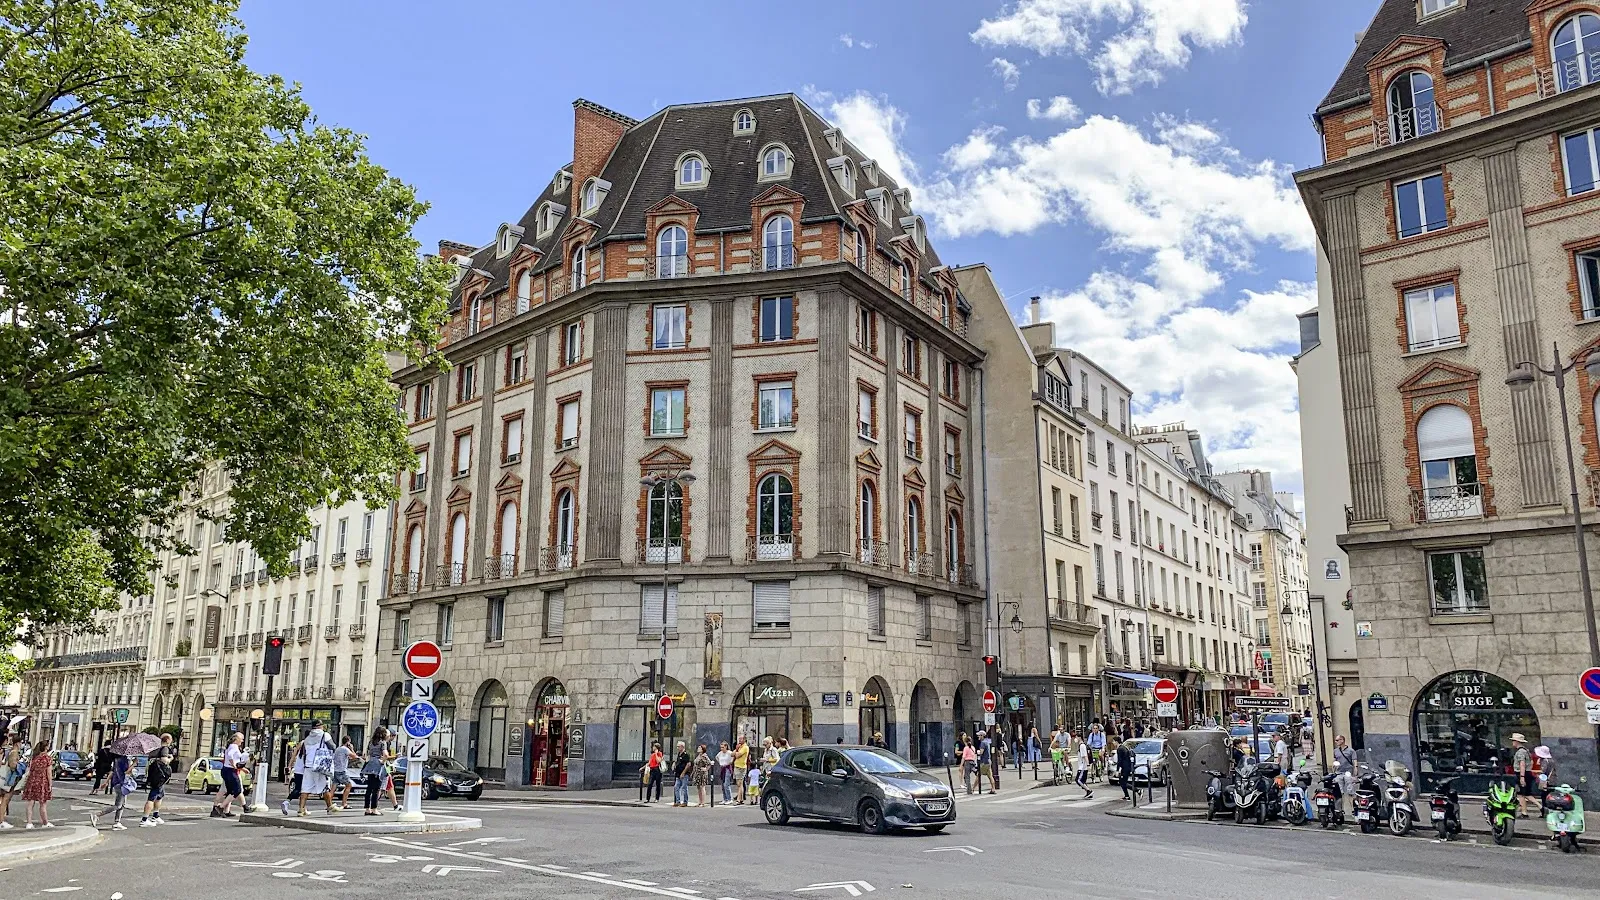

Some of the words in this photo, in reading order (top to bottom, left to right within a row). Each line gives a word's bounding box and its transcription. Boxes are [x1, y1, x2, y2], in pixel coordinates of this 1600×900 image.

[207, 610, 217, 644] citadines
[756, 686, 794, 699] MIZEN
[1464, 685, 1482, 695] DE
[1454, 696, 1494, 706] SIEGE
